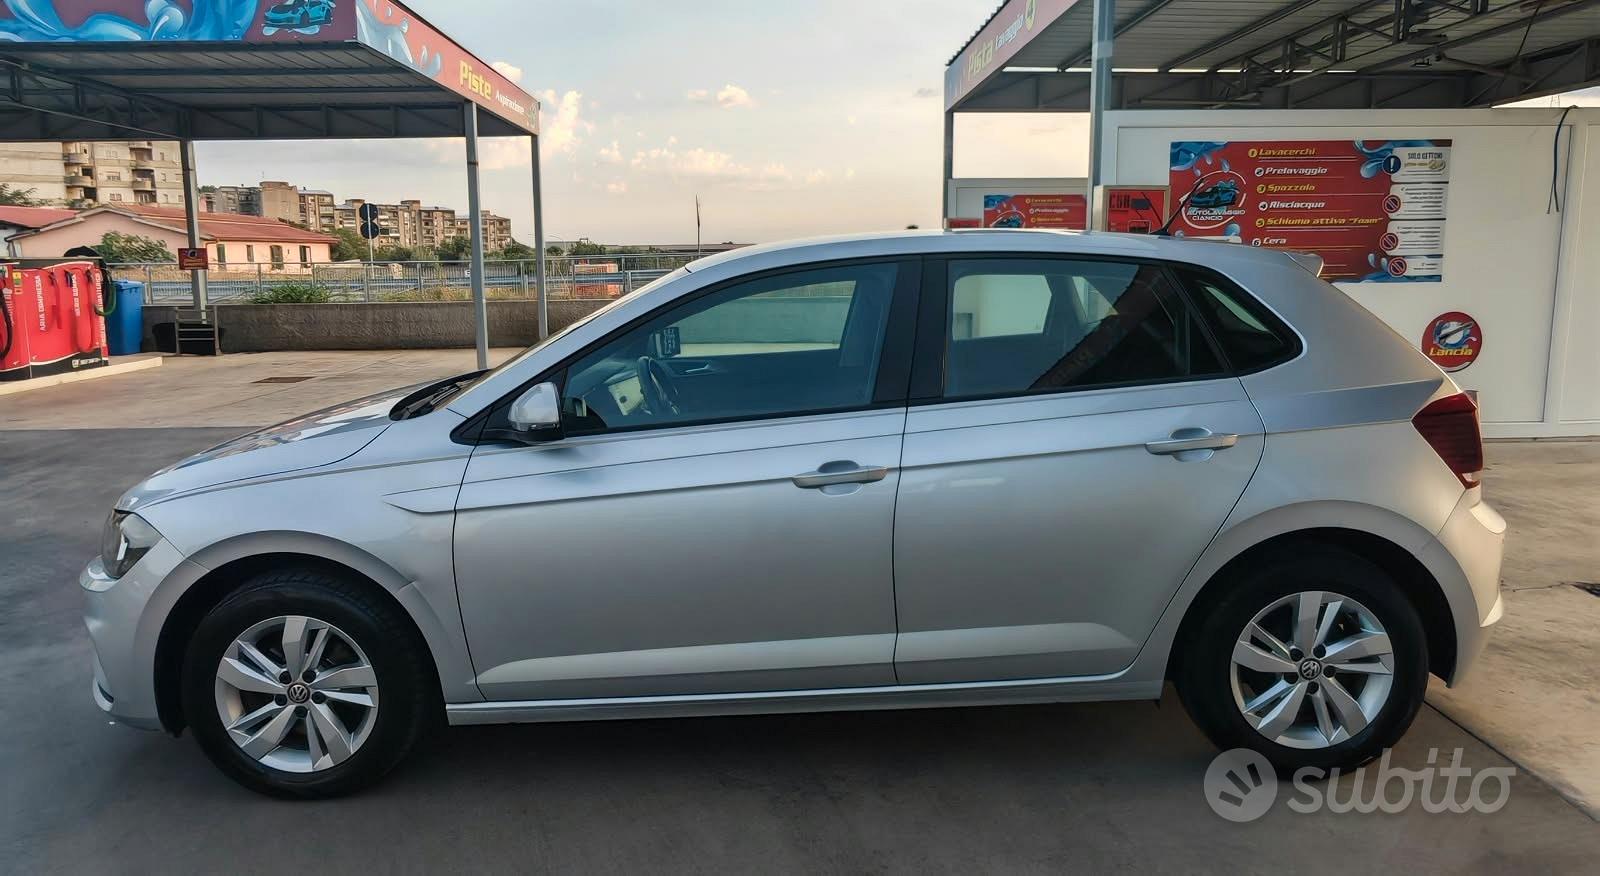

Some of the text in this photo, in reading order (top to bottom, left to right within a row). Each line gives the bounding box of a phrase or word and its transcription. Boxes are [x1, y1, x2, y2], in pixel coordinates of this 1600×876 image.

[968, 40, 994, 77] Pista
[459, 59, 492, 100] Piste
[1259, 148, 1316, 156] Lavacerchi
[1265, 167, 1328, 176] Prelavaggio
[1267, 183, 1316, 193] Spazzola
[1269, 200, 1326, 210] Risciacquo
[1266, 216, 1311, 225] Schiuma
[1312, 217, 1346, 225] attiva
[1263, 237, 1287, 245] Cera
[1429, 346, 1474, 356] Lancia
